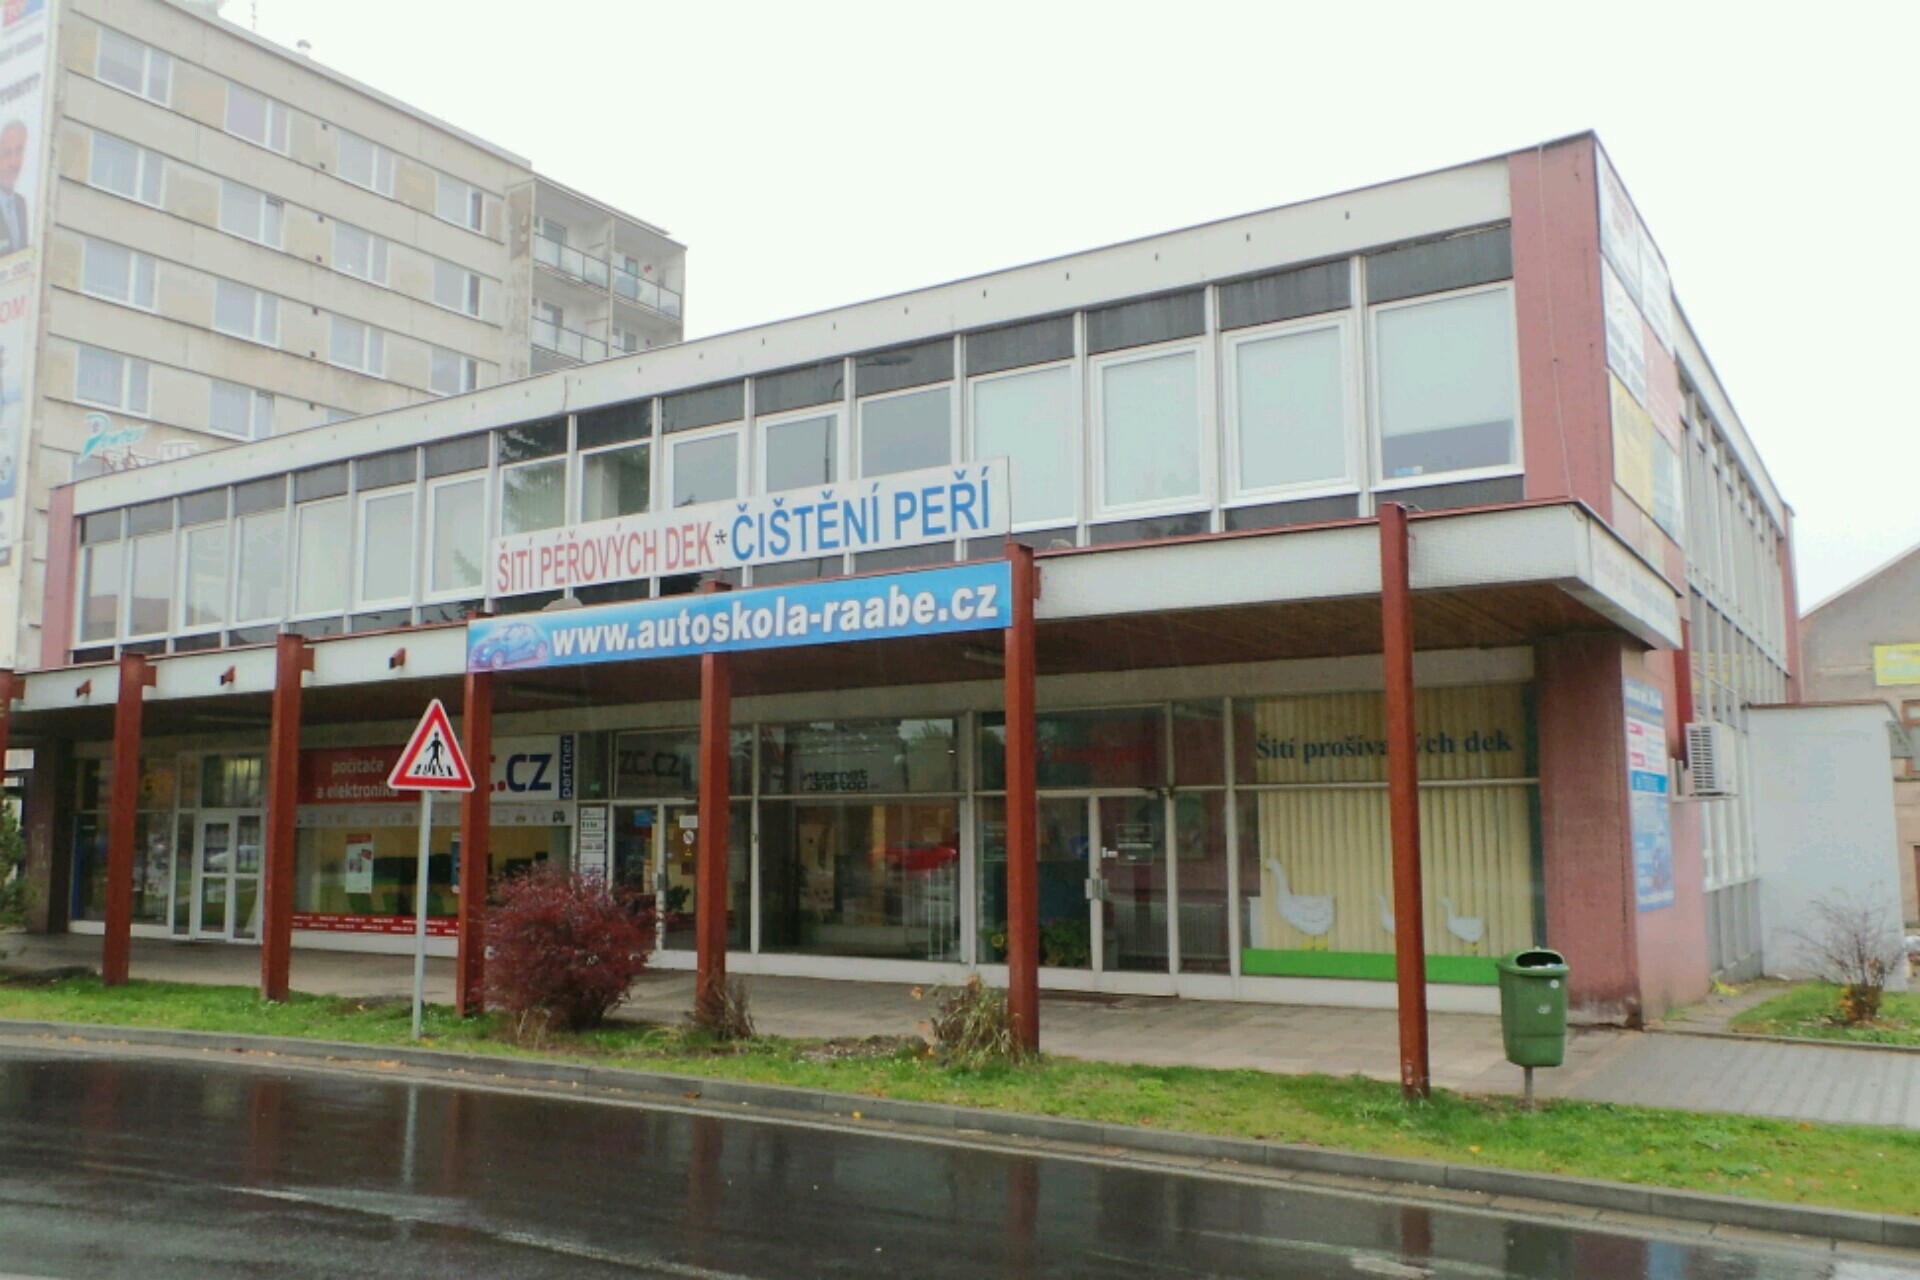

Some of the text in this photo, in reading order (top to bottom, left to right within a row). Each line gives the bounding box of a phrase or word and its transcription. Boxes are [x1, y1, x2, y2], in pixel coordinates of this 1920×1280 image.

[497, 466, 990, 593] ŠITÍ PÉŘOVÝCH DEK ČIŠTĚNÍ PEŘÍ
[552, 583, 999, 656] www.autoskola-raabe.cz
[332, 757, 384, 777] počítače
[562, 736, 573, 798] partner
[1256, 729, 1513, 765] Šití prošívach dek
[316, 788, 324, 798] a
